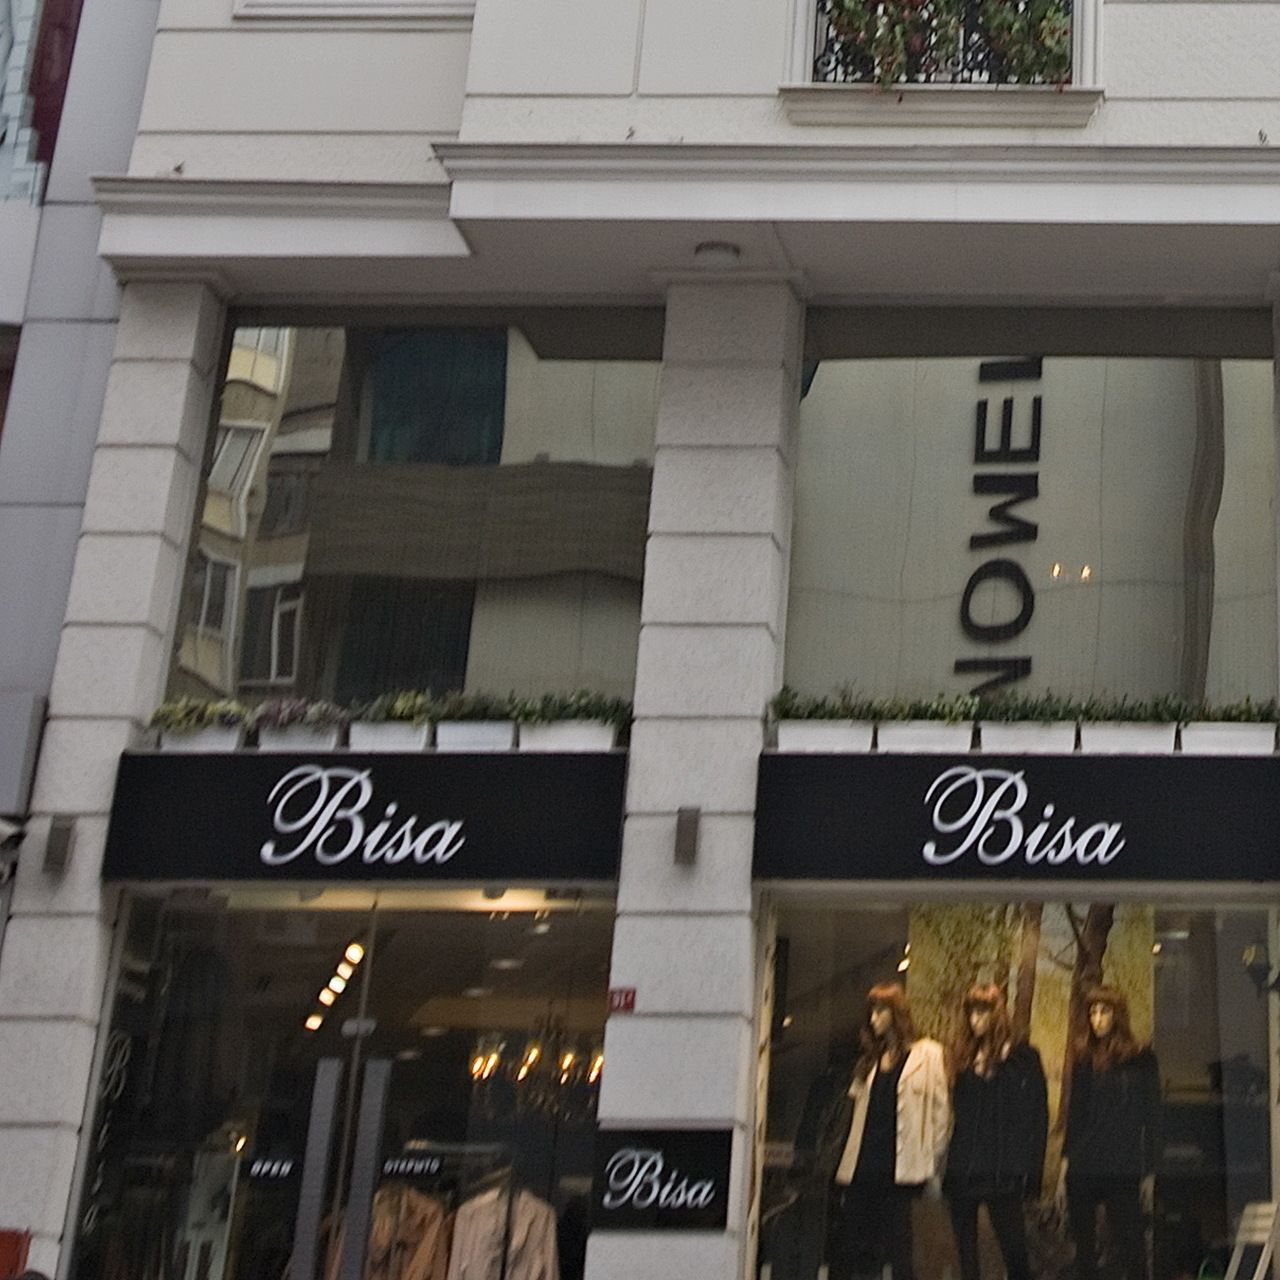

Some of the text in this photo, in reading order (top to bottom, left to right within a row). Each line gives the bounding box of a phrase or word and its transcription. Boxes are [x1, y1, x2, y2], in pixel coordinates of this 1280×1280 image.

[259, 764, 466, 865] Bisa
[922, 765, 1126, 866] Bisa
[250, 1159, 294, 1178] OPEN
[603, 1146, 715, 1210] Bisa
